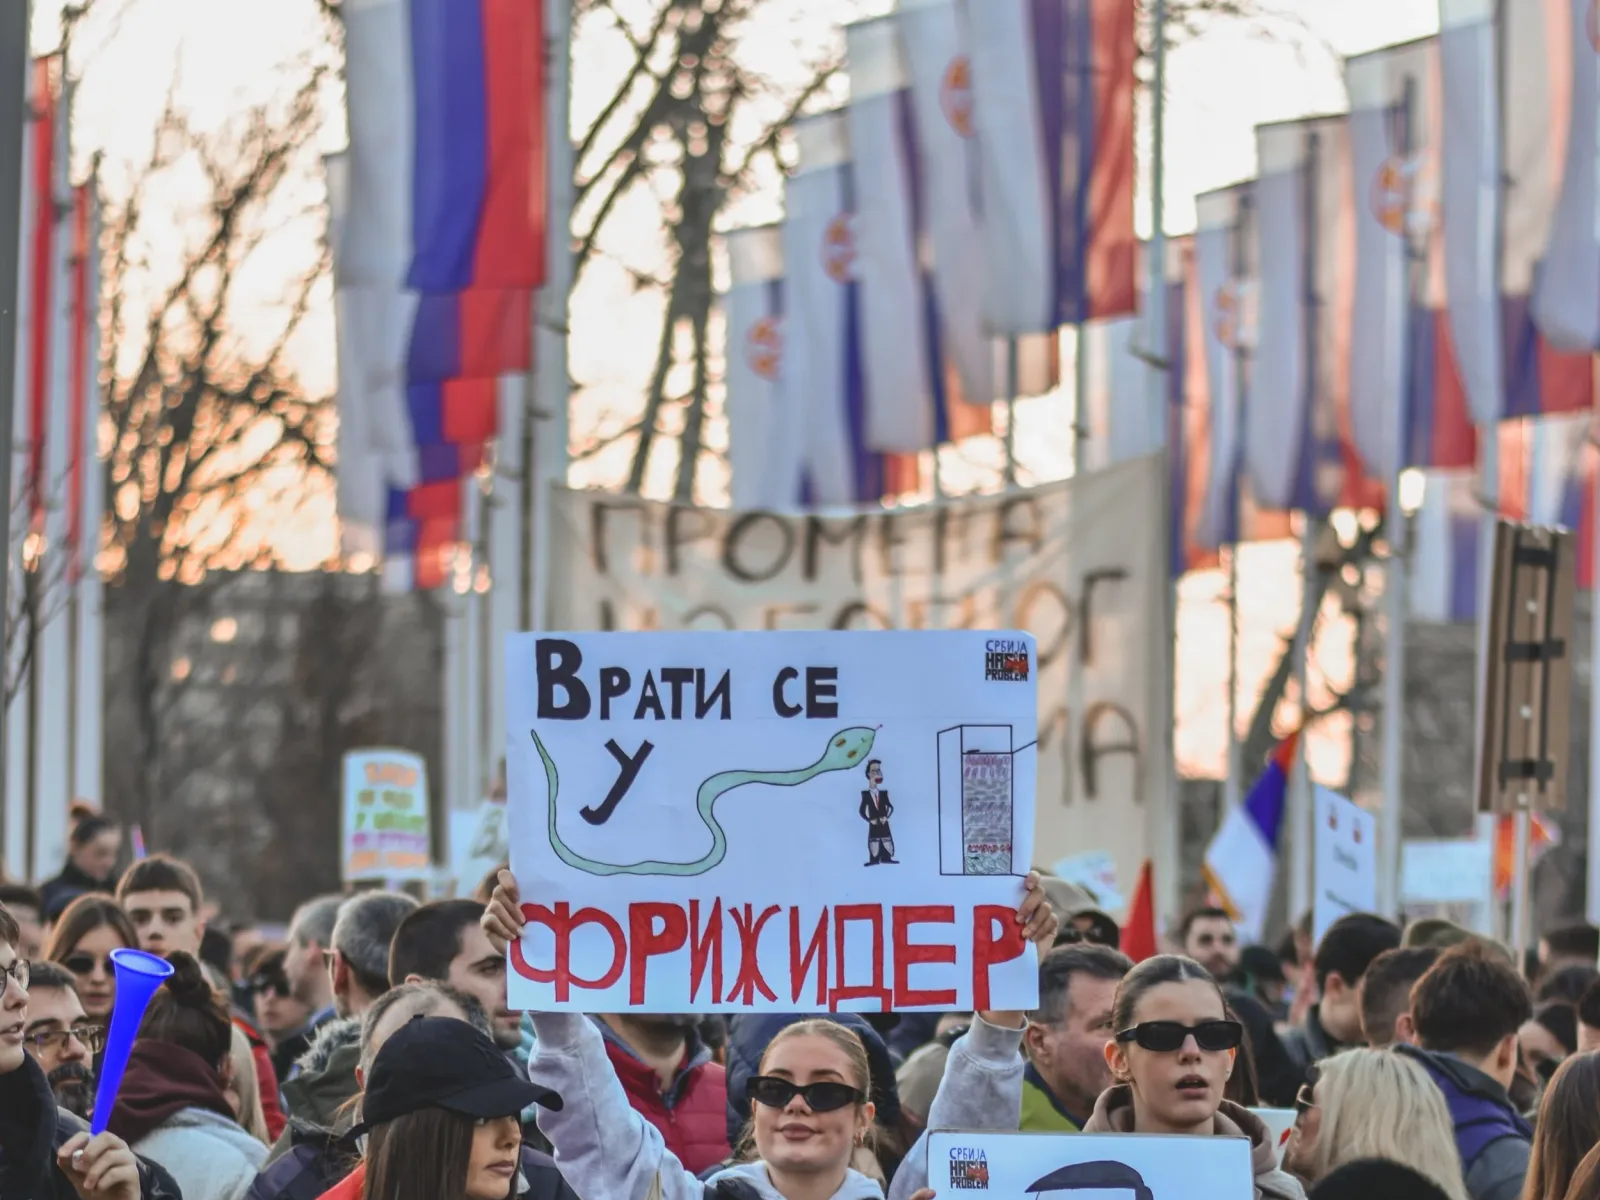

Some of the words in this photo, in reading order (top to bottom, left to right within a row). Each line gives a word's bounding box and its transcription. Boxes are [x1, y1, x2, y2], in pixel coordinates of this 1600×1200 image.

[985, 639, 1028, 653] СРБИЈА
[772, 666, 838, 719] СЕ
[579, 738, 654, 826] У
[509, 896, 1027, 1013] ФРИЖИДЕР
[949, 1147, 987, 1161] СРБИЈА
